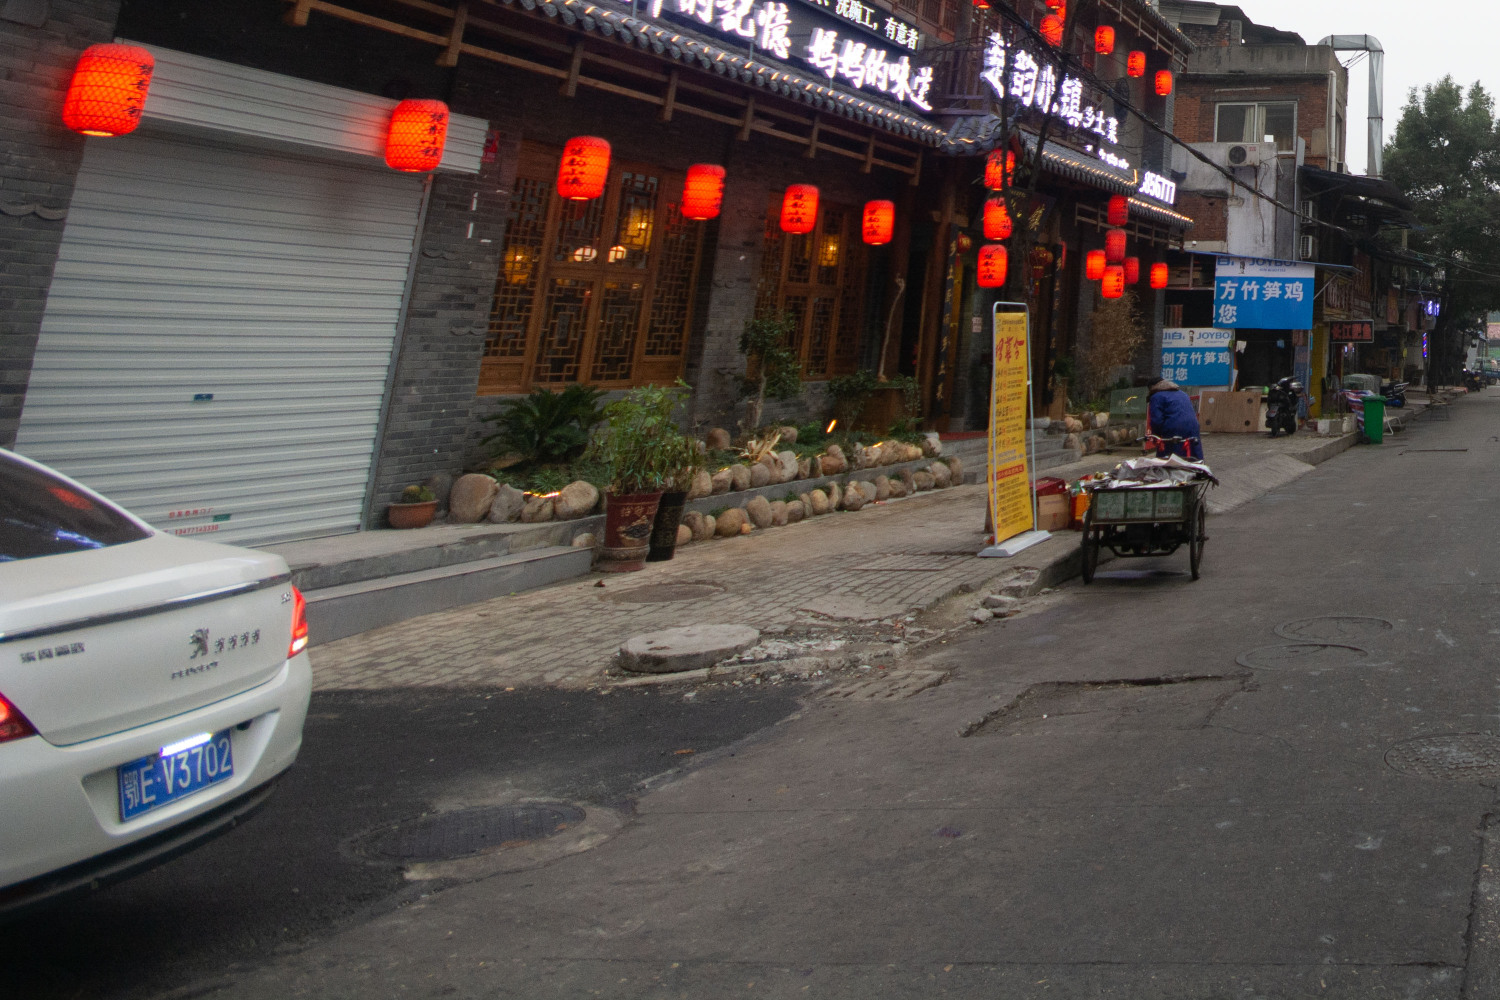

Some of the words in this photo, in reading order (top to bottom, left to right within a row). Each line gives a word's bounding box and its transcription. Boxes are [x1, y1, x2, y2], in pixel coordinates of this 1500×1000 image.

[1214, 280, 1304, 302] 方竹笋鸡
[1196, 331, 1232, 341] JOYBO
